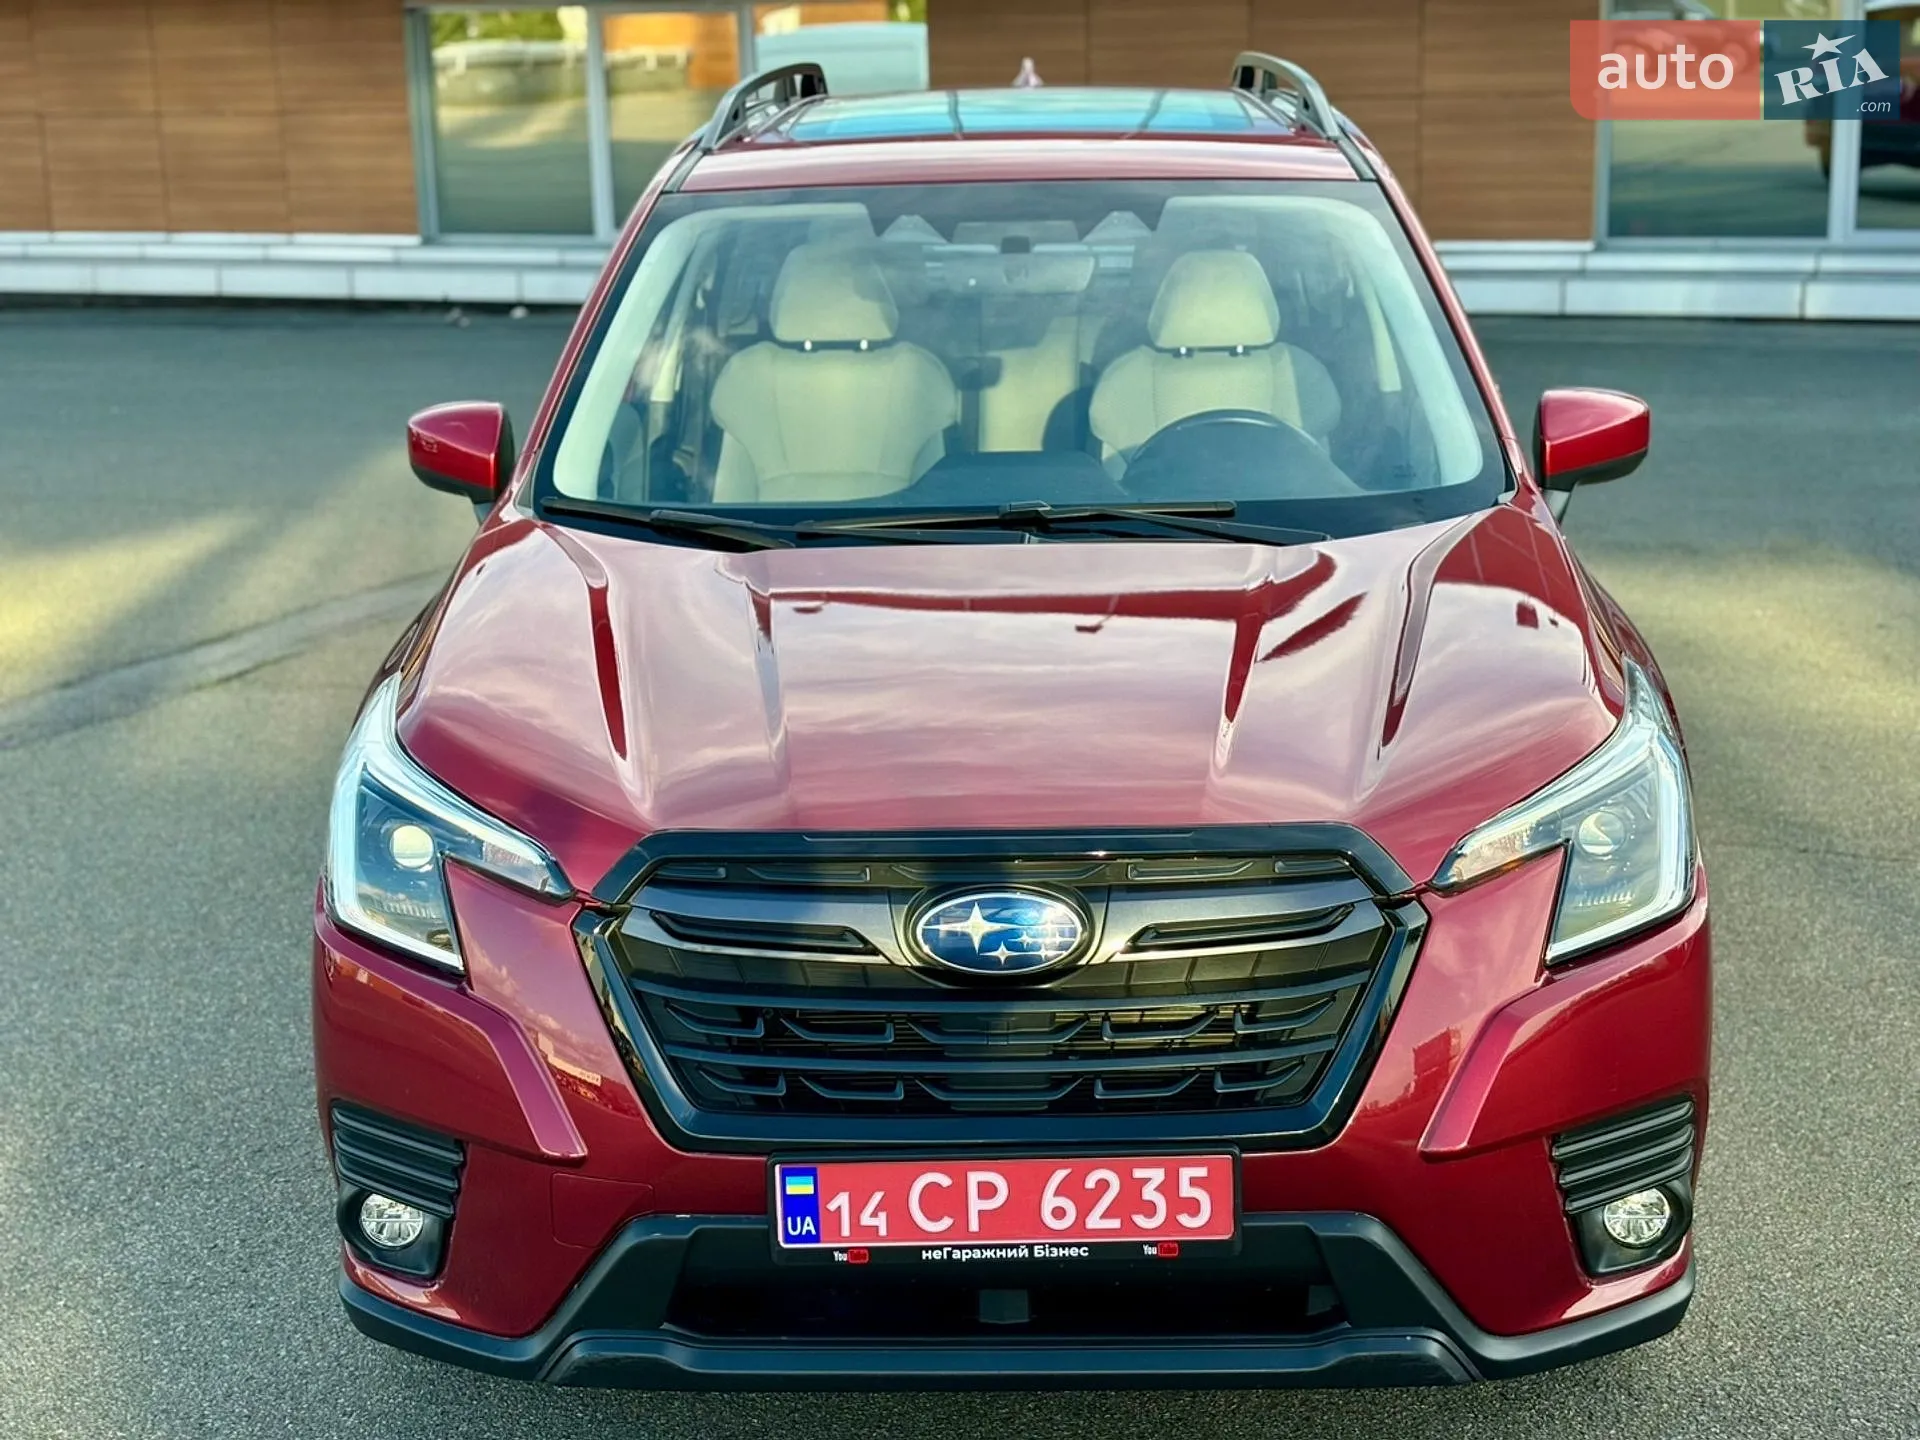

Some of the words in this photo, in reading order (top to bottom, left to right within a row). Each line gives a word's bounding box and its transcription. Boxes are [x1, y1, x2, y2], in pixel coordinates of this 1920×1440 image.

[825, 1191, 888, 1236] 14
[908, 1170, 1009, 1233] CP
[1041, 1167, 1213, 1230] 6235
[787, 1216, 817, 1236] UA
[922, 1246, 1028, 1261] неГаражний
[1034, 1244, 1089, 1258] Бізнес
